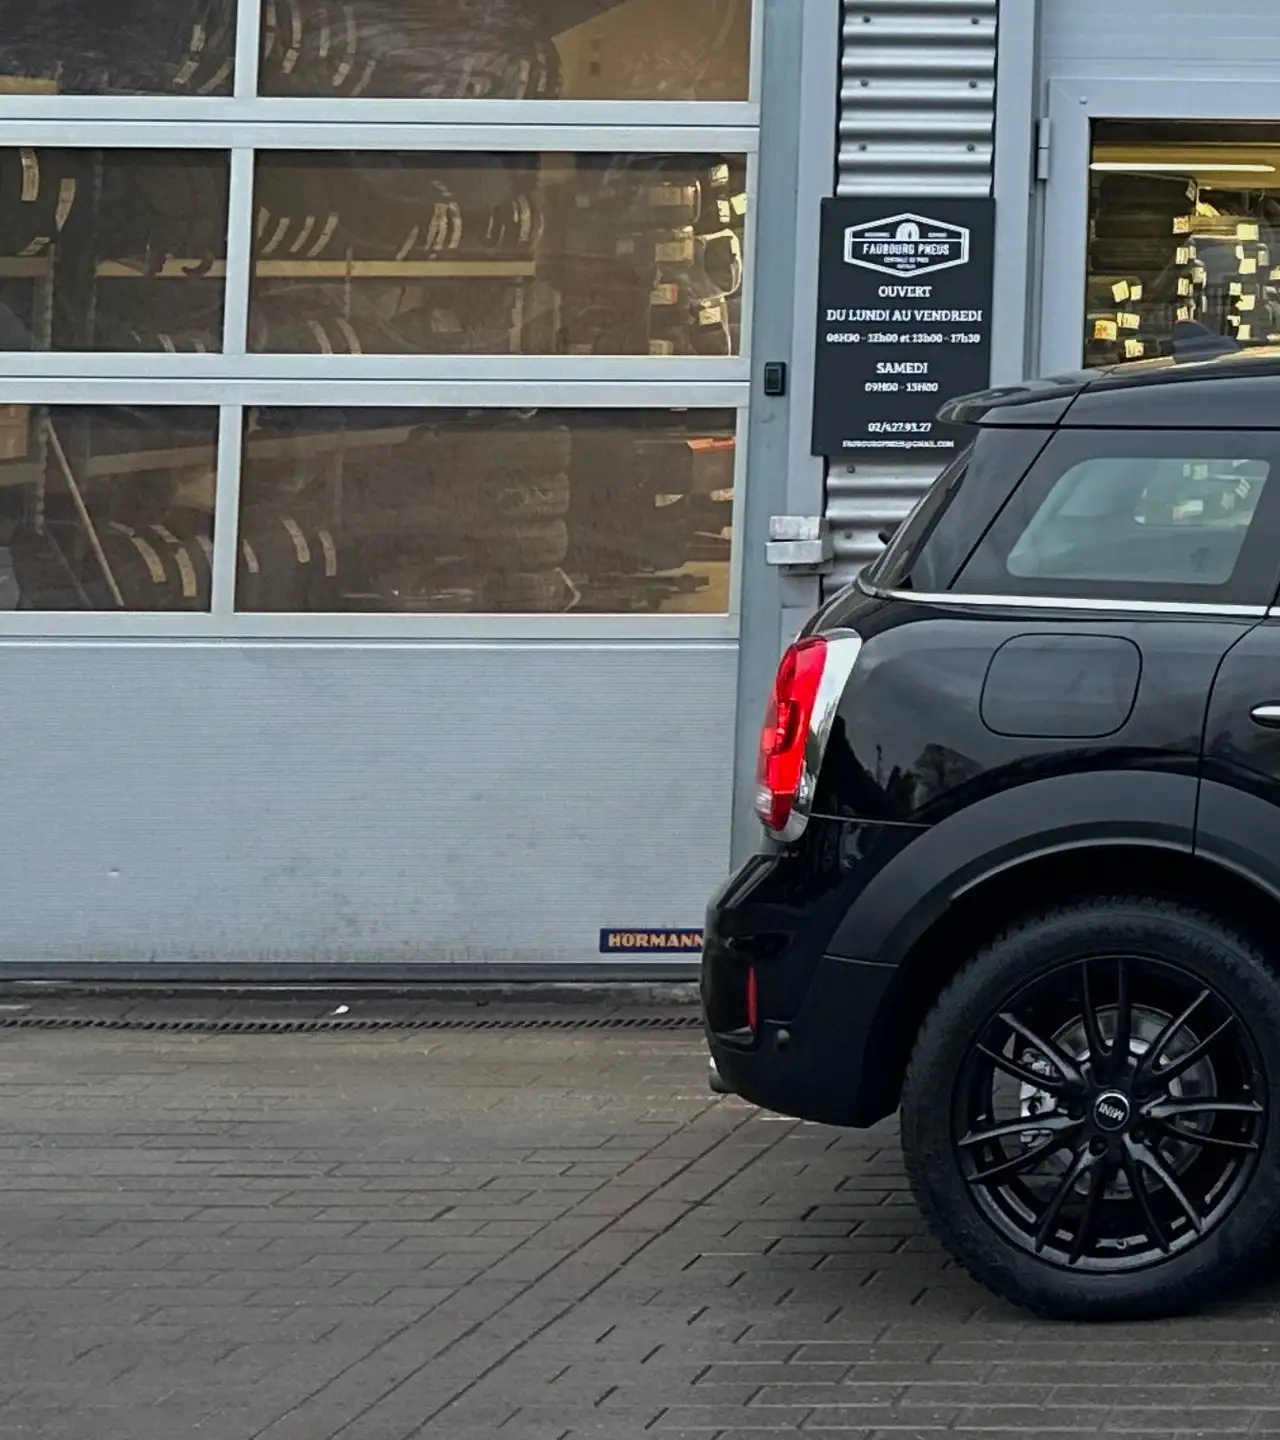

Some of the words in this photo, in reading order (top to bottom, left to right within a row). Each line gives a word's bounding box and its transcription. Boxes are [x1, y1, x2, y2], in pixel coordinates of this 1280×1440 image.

[878, 285, 933, 298] OUVERT
[826, 308, 847, 322] DU
[848, 308, 891, 322] LUNDI
[892, 309, 912, 322] AU
[914, 309, 983, 322] VENDREDI
[875, 362, 929, 374] SAMEDI
[1098, 1102, 1125, 1121] MINI
